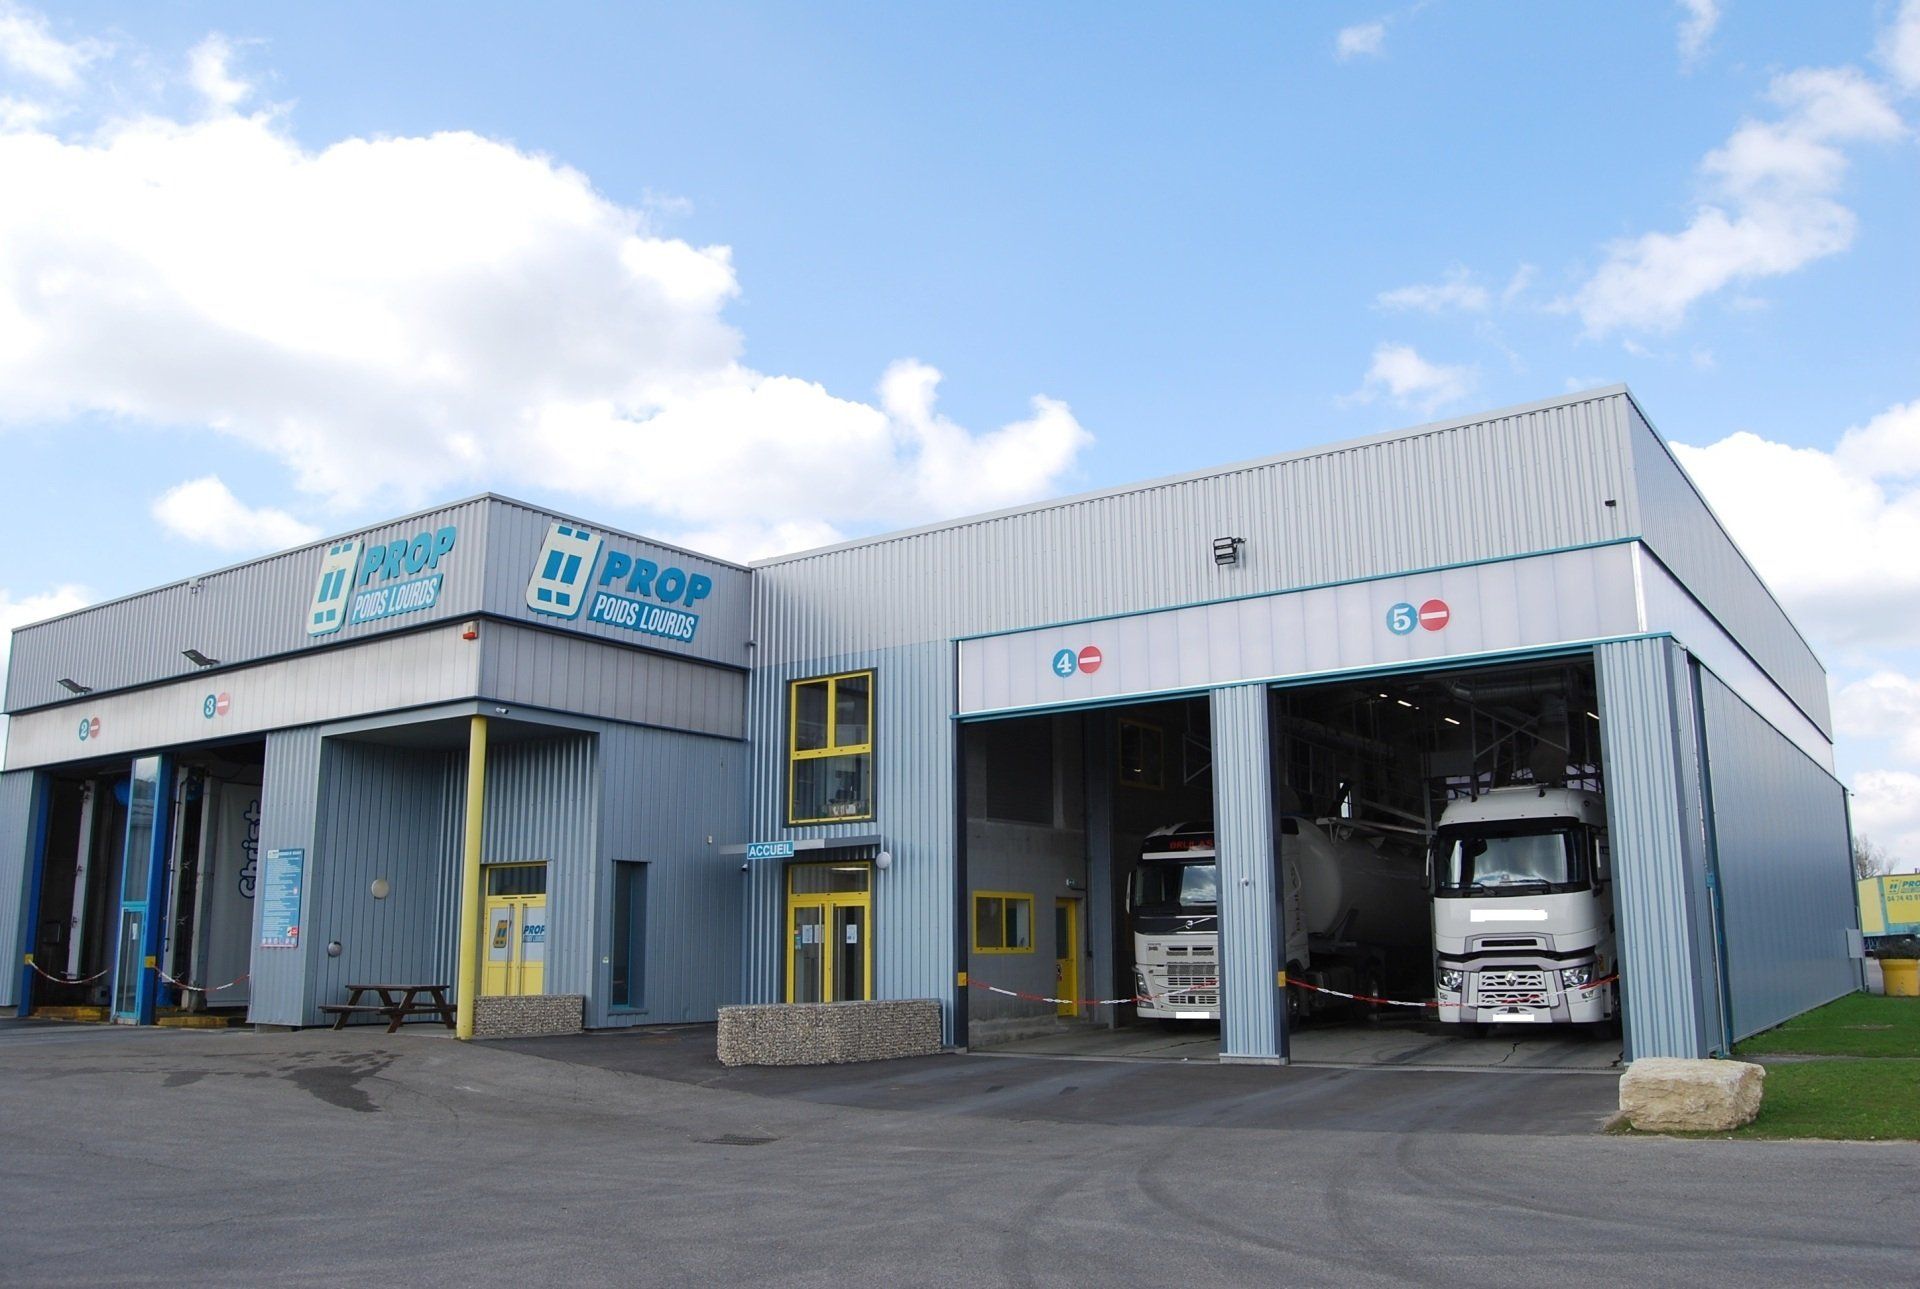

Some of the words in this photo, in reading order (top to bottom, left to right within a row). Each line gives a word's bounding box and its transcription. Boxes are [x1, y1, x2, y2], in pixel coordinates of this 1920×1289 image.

[359, 526, 457, 587] PROP
[352, 589, 388, 620] POIDS
[388, 578, 437, 611] LOURDS
[598, 551, 712, 607] PROP
[593, 594, 639, 626] POIDS
[639, 606, 695, 639] LOURDS
[1393, 607, 1411, 631] 5
[1057, 653, 1072, 673] 4
[749, 843, 793, 857] ACCUEIL
